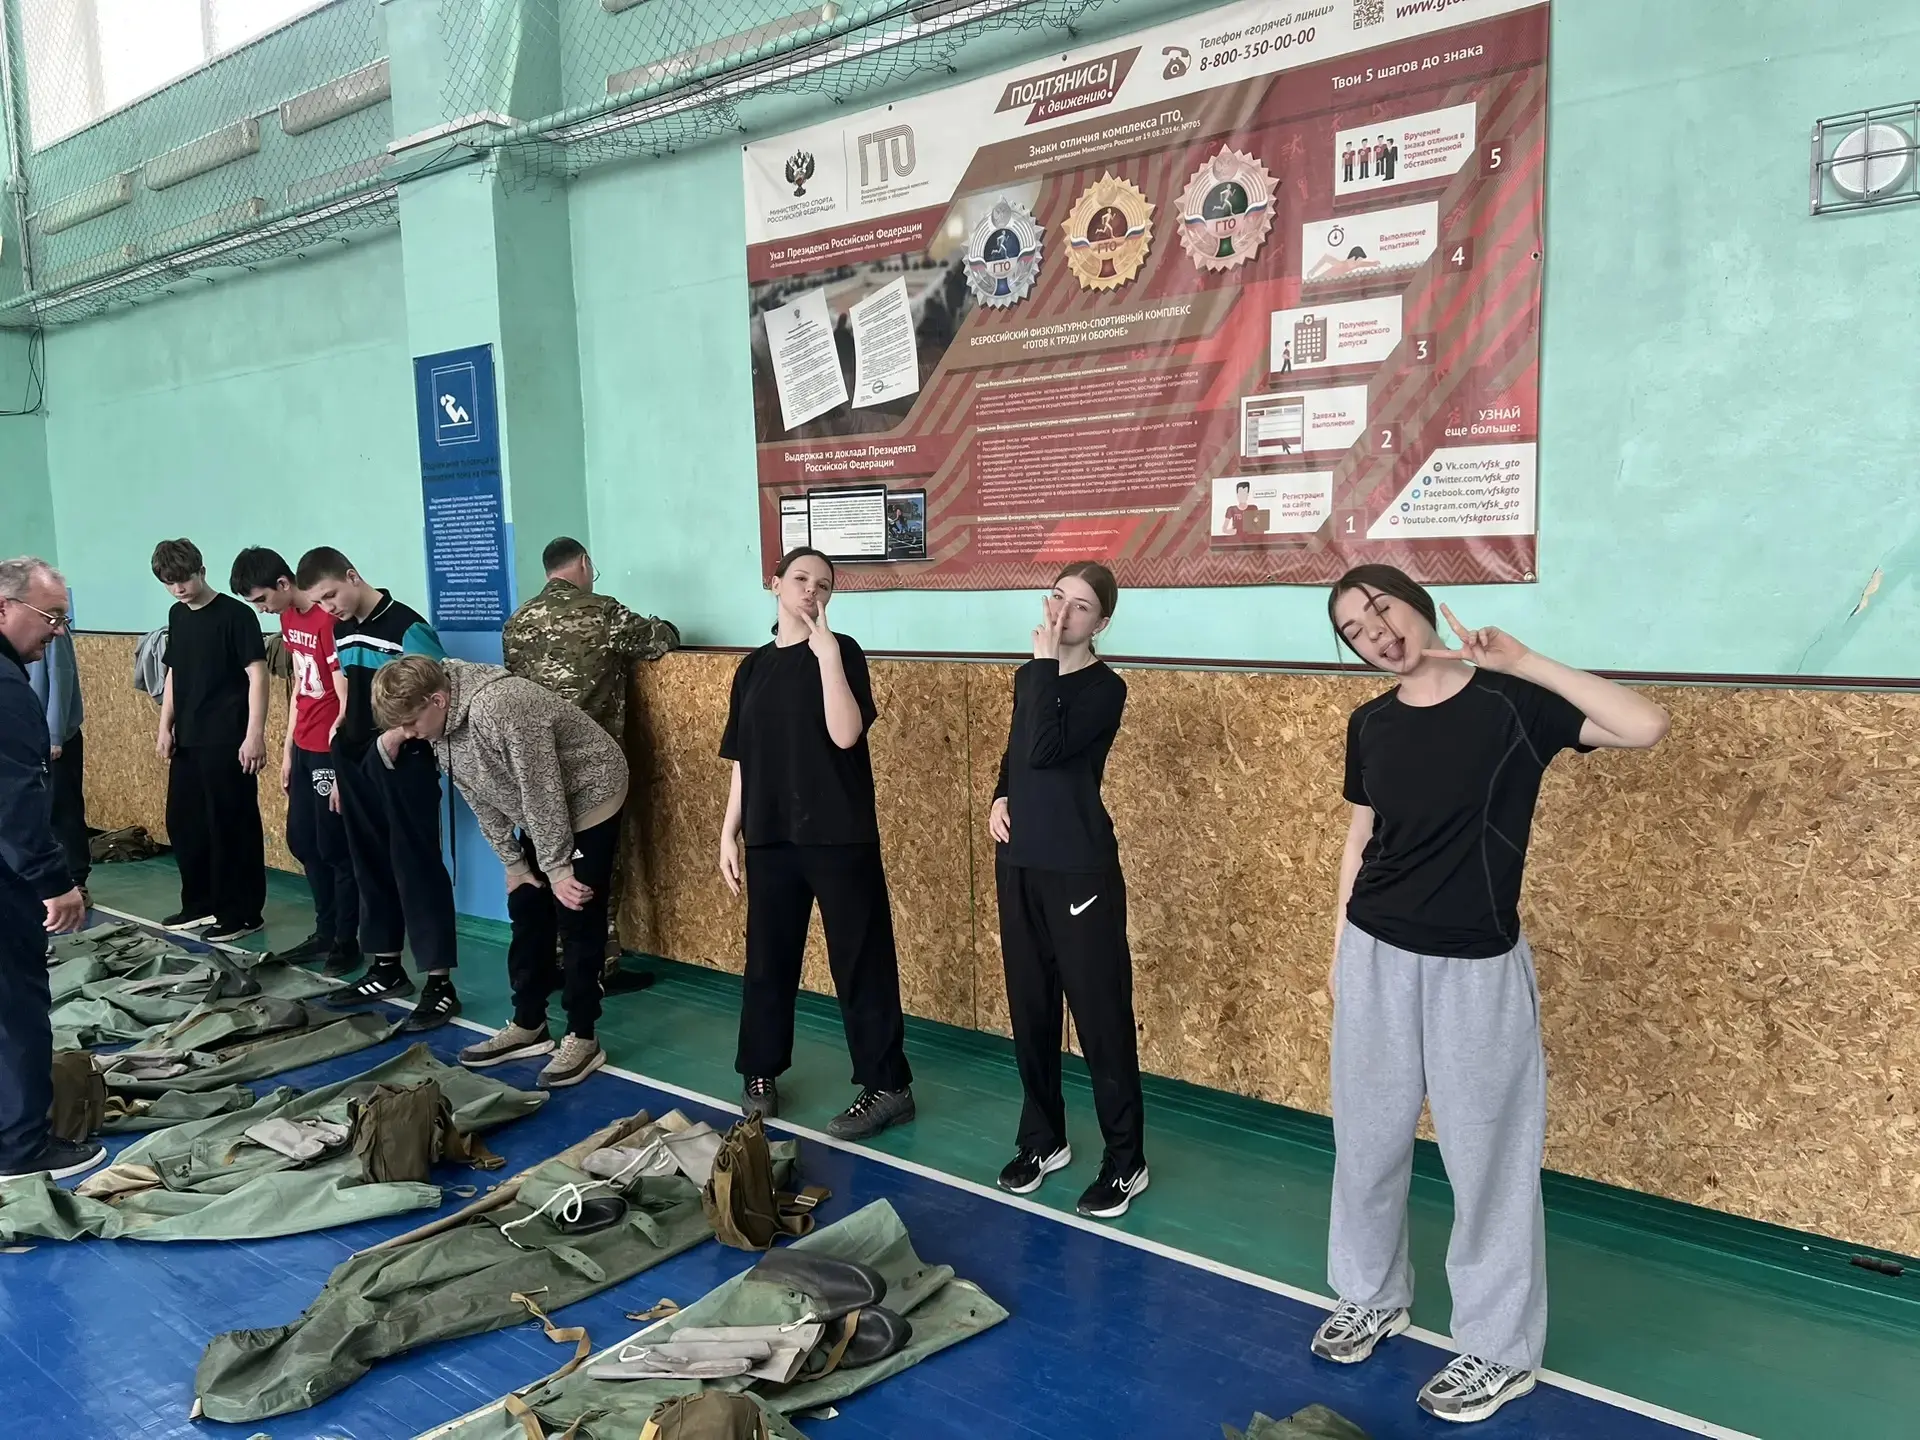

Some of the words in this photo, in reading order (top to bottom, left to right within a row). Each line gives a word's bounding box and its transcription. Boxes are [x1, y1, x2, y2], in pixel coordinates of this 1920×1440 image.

[1200, 31, 1241, 49] Телефон
[1246, 14, 1292, 41] «горячей
[1294, 4, 1334, 25] линии»
[1200, 27, 1315, 71] 8-800-350-00-00
[1332, 75, 1361, 90] Твои
[1366, 69, 1373, 82] 5
[1378, 60, 1418, 80] шагов
[1422, 56, 1440, 74] до
[1444, 45, 1483, 67] знака
[1038, 105, 1045, 115] к
[1029, 142, 1057, 156] Знаки
[1060, 133, 1099, 148] отличия
[1102, 119, 1157, 140] комплекса
[1160, 109, 1184, 125] ГТО,
[1404, 128, 1440, 141] Вручение
[1404, 140, 1425, 150] знака
[1427, 133, 1459, 146] отличия
[858, 124, 916, 186] ГТО
[1014, 152, 1053, 171] утвержденные
[1054, 147, 1080, 161] приказом
[1082, 140, 1112, 154] Минспорта
[1113, 134, 1134, 148] России
[1135, 132, 1142, 140] от
[1404, 142, 1461, 159] торжественной
[1490, 147, 1502, 169] 5
[1404, 156, 1447, 169] обстановке
[767, 210, 803, 224] РОССИЙСКОЙ
[803, 203, 836, 217] ФЕДЕРАЦИИ
[770, 202, 809, 215] МИНИСТЕРСТВО
[811, 196, 834, 207] СПОРТА
[1215, 218, 1236, 233] ГТО
[770, 247, 785, 261] Указ
[787, 242, 830, 259] Президента
[831, 231, 875, 249] Российской
[876, 222, 922, 240] Федерации
[1380, 229, 1426, 243] Выполнение
[1098, 240, 1117, 254] ГТО
[1380, 239, 1420, 252] испытаний
[1451, 247, 1465, 266] 4
[993, 261, 1011, 279] ГТО
[971, 327, 1029, 346] ВСЕРОССИЙСКИЙ
[1030, 313, 1144, 338] ФИЗКУЛЬТУРНО-СПОРТИВНЫЙ
[1145, 305, 1191, 322] КОМПЛЕКС
[1338, 320, 1378, 333] Получение
[1338, 327, 1390, 340] медицинского
[1023, 336, 1049, 350] «ГОТОВ
[1050, 336, 1056, 346] К
[1057, 331, 1080, 345] ТРУДУ
[1081, 332, 1087, 342] И
[1088, 326, 1128, 341] ОБОРОНЕ»
[1338, 338, 1368, 350] допуска
[1416, 340, 1427, 359] 3
[1312, 411, 1335, 422] Заявка
[1336, 410, 1346, 418] на
[1479, 405, 1520, 420] УЗНАЙ
[1312, 418, 1355, 430] выполнение
[1445, 427, 1468, 437] еще
[1471, 424, 1520, 436] больше:
[1381, 430, 1393, 448] 2
[785, 451, 825, 463] Выдержка
[825, 451, 833, 459] из
[834, 447, 867, 460] доклада
[869, 444, 917, 458] Президента
[805, 458, 848, 472] Российской
[850, 454, 894, 470] Федерации
[1446, 460, 1520, 470] Vk.com/vfsk_gto
[1435, 473, 1520, 484] Twitter.com/vfsk_gto
[1282, 492, 1325, 502] Регистрация
[1424, 486, 1520, 498] Facebook.com/vfskgto
[1292, 500, 1311, 509] сайте
[1413, 500, 1520, 511] Instagram.com/vfsk_gto
[1281, 509, 1320, 519] www.gto.ru
[1402, 513, 1519, 524] Youtube.com/vfskgtorussia
[1345, 516, 1356, 533] 1
[288, 628, 318, 649] SEATTLE
